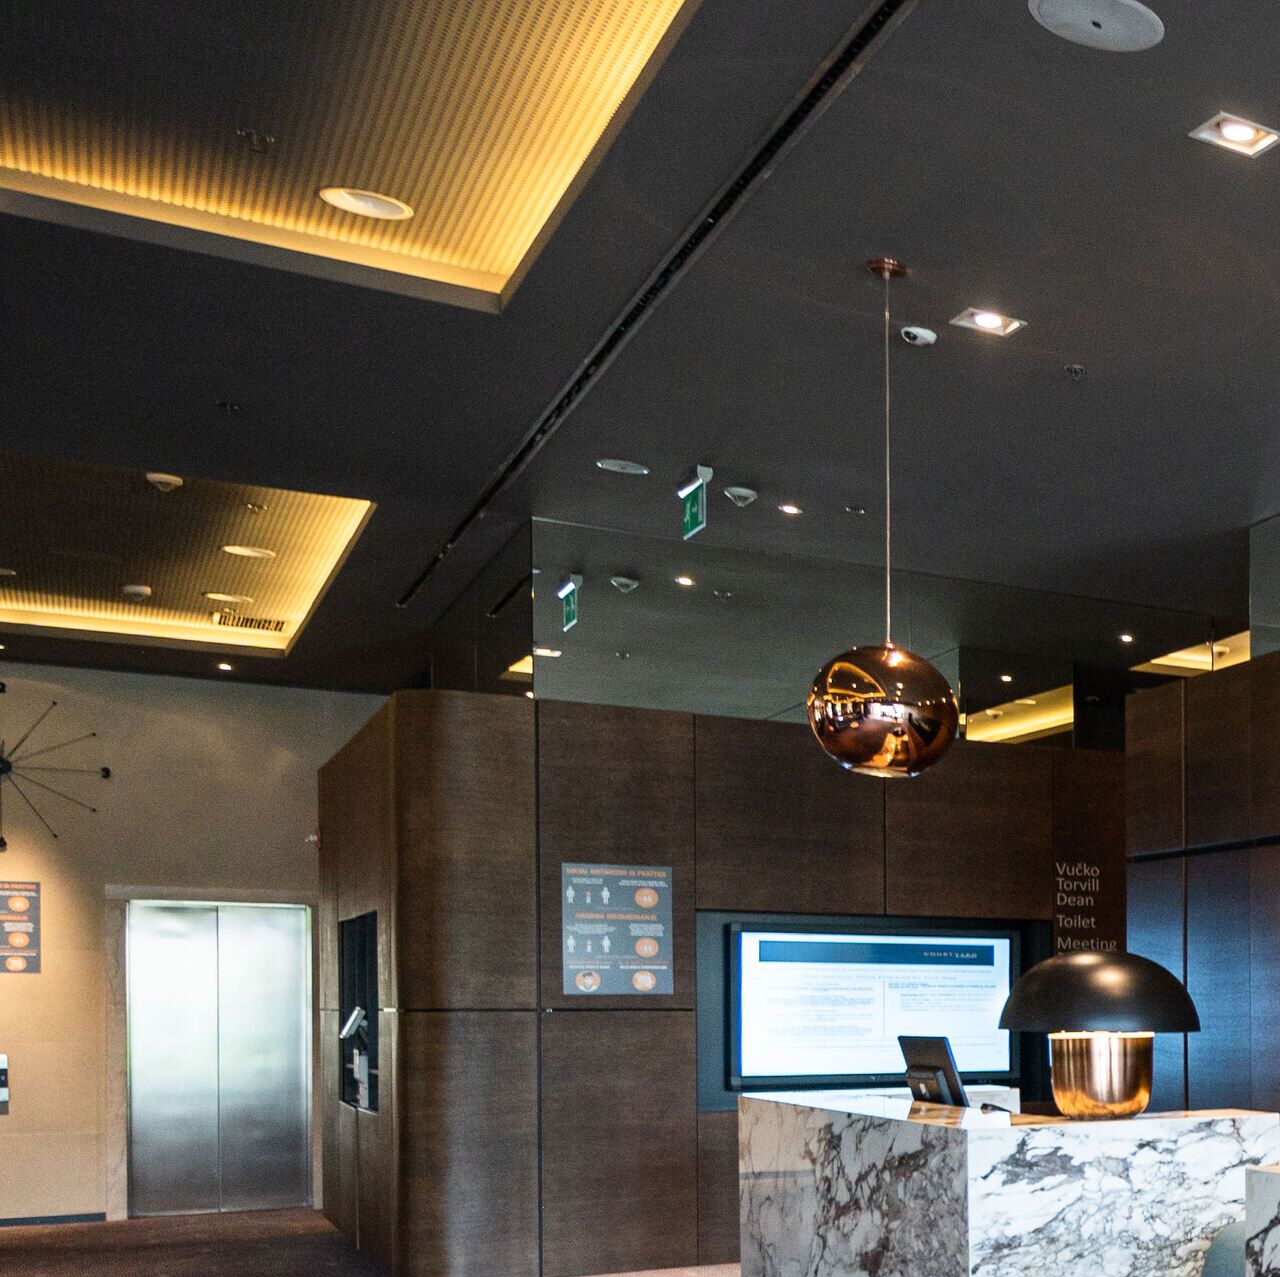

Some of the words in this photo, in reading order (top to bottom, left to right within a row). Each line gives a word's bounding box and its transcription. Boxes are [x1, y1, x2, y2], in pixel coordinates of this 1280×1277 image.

[1056, 862, 1100, 877] Vučko
[1056, 877, 1100, 891] Torvill
[1057, 892, 1094, 906] Dean
[1056, 914, 1096, 928] Toilet
[1057, 937, 1117, 952] Meeting
